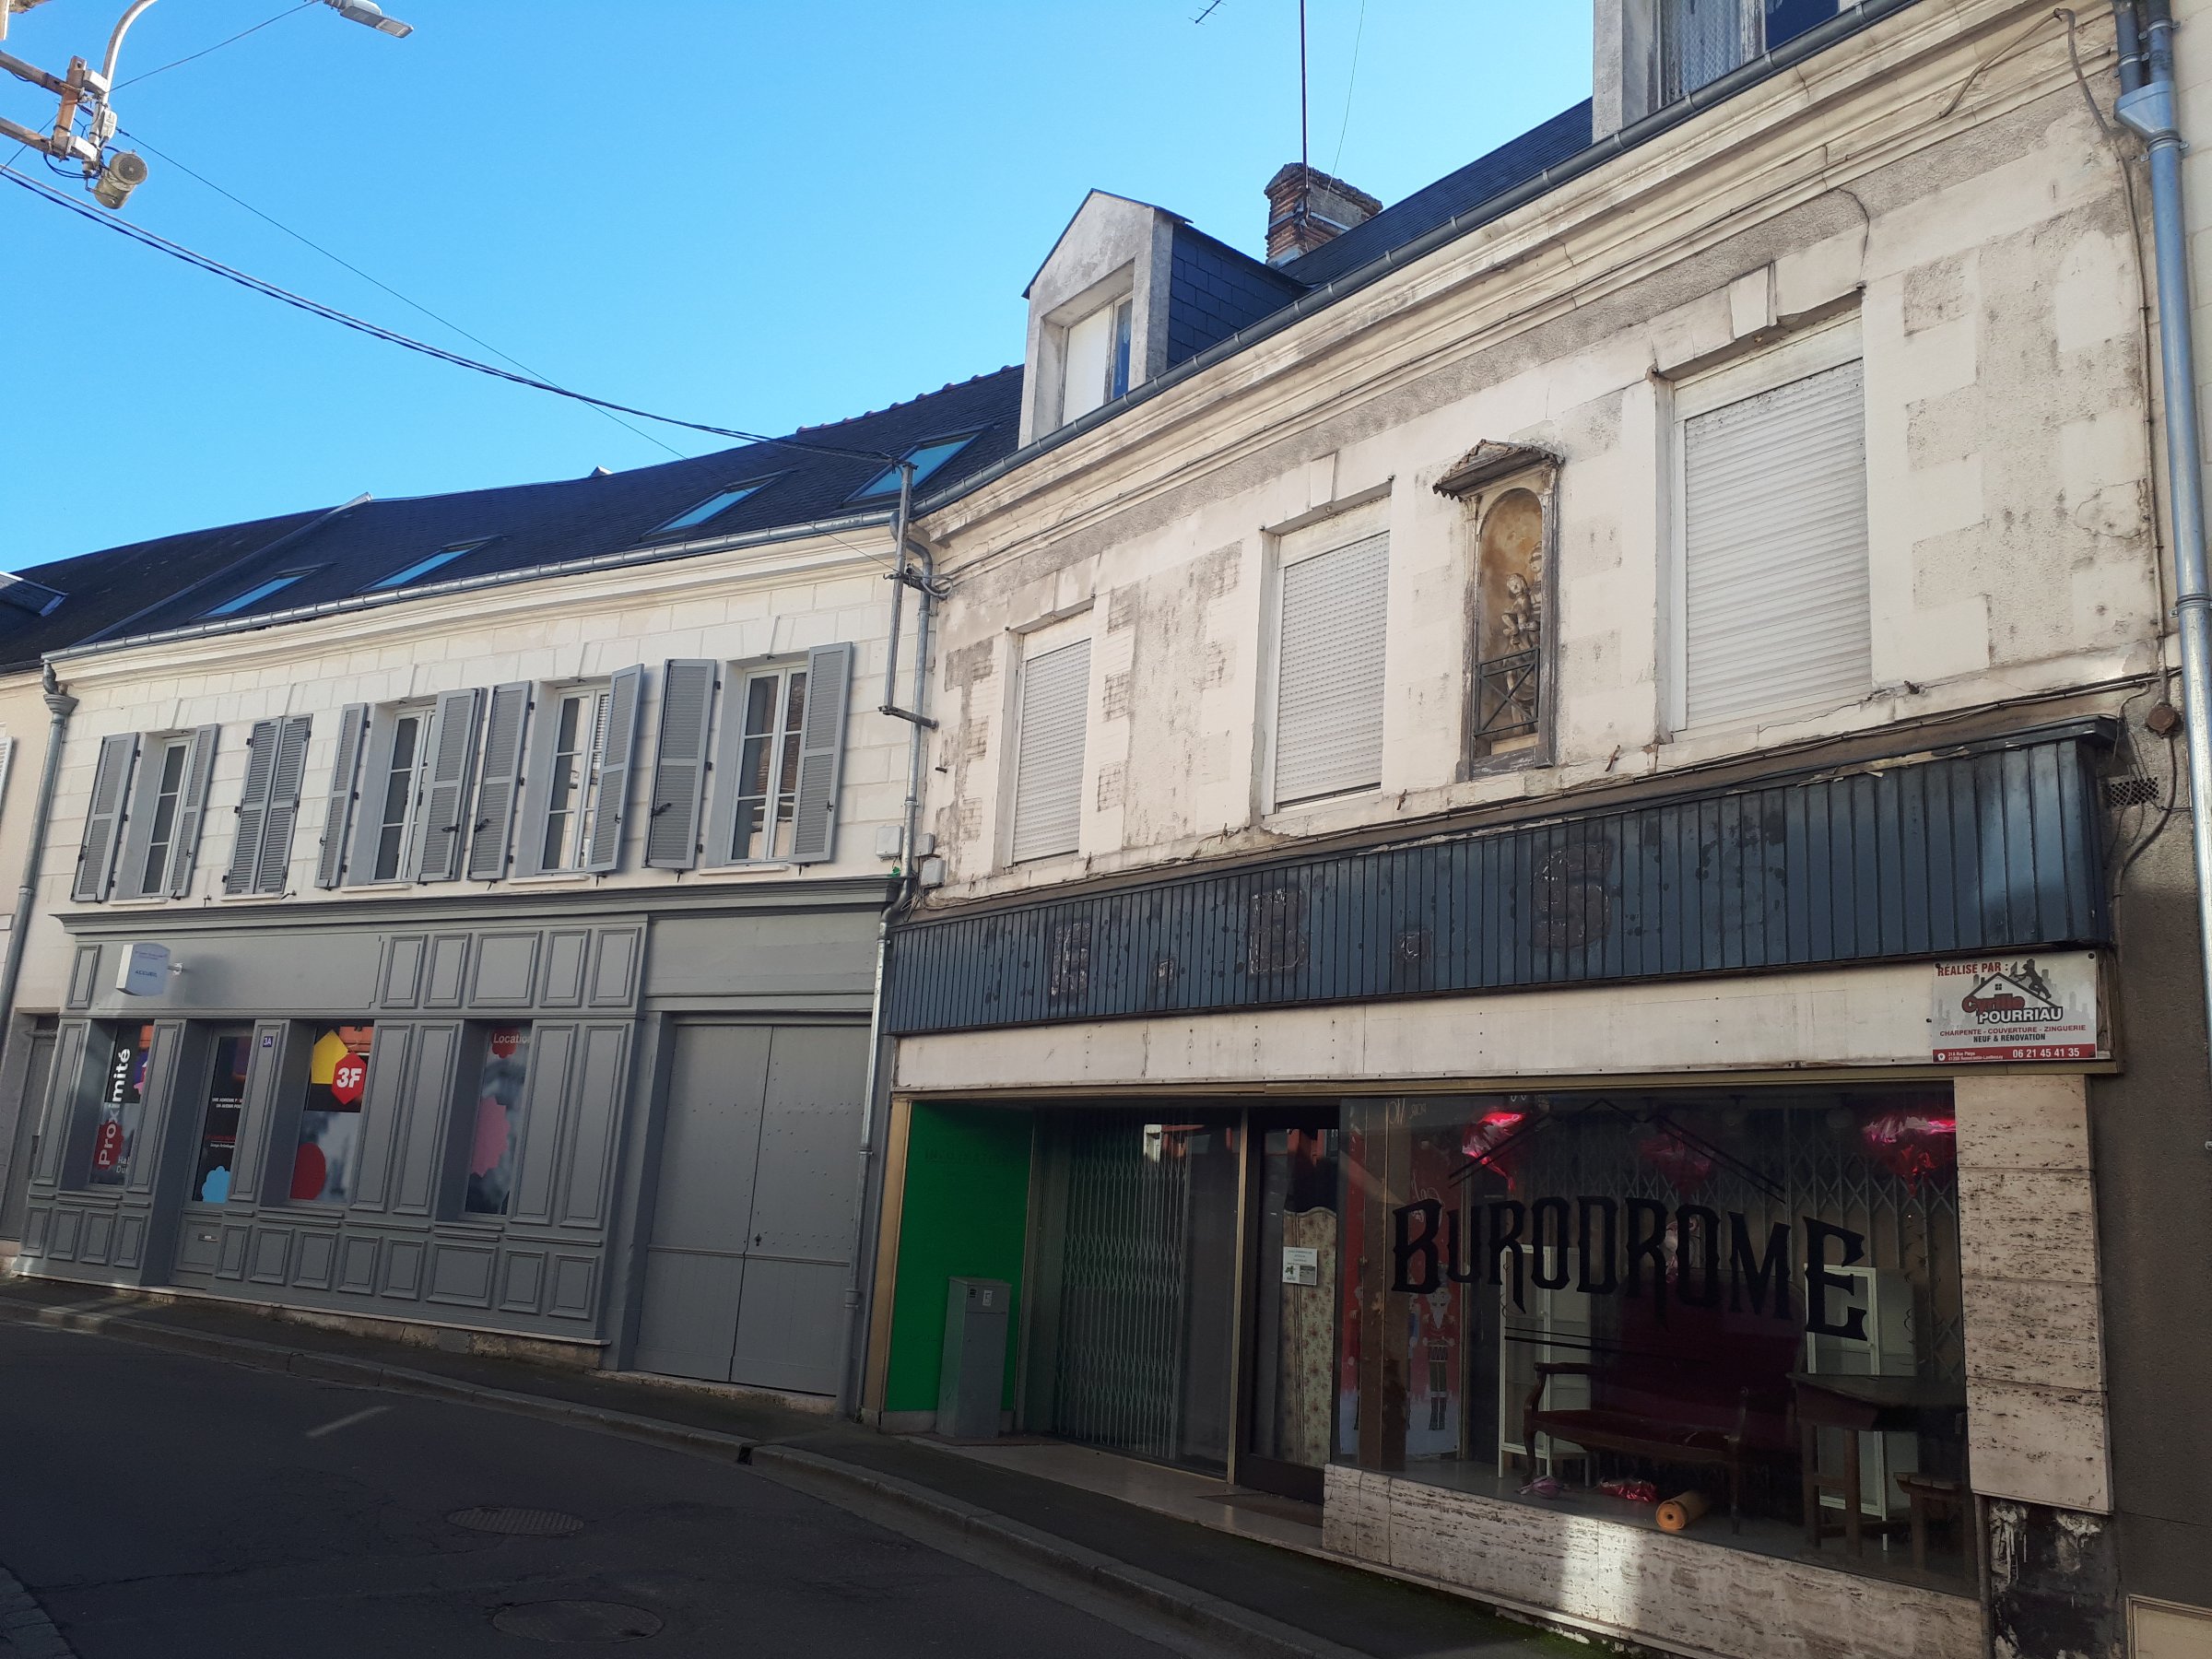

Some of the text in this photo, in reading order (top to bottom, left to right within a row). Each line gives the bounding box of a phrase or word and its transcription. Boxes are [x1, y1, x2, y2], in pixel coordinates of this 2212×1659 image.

[1937, 962, 1978, 977] RÉALISÉ
[1982, 961, 2002, 973] PAR
[1961, 993, 2026, 1017] Cyrille
[1978, 1006, 2064, 1025] POURRIAU
[1939, 1029, 1983, 1038] CHARPENTE
[1987, 1026, 2038, 1035] COUVERTURE
[2043, 1024, 2087, 1033] ZINGUERIE
[1973, 1032, 2046, 1043] NEUF & RÉNOVATION
[264, 1037, 272, 1046] 3A
[2012, 1047, 2080, 1059] 06 21 45 41 35
[336, 1067, 362, 1088] 3F
[98, 1048, 131, 1166] Proximité
[1391, 1196, 1868, 1341] BURODROME
